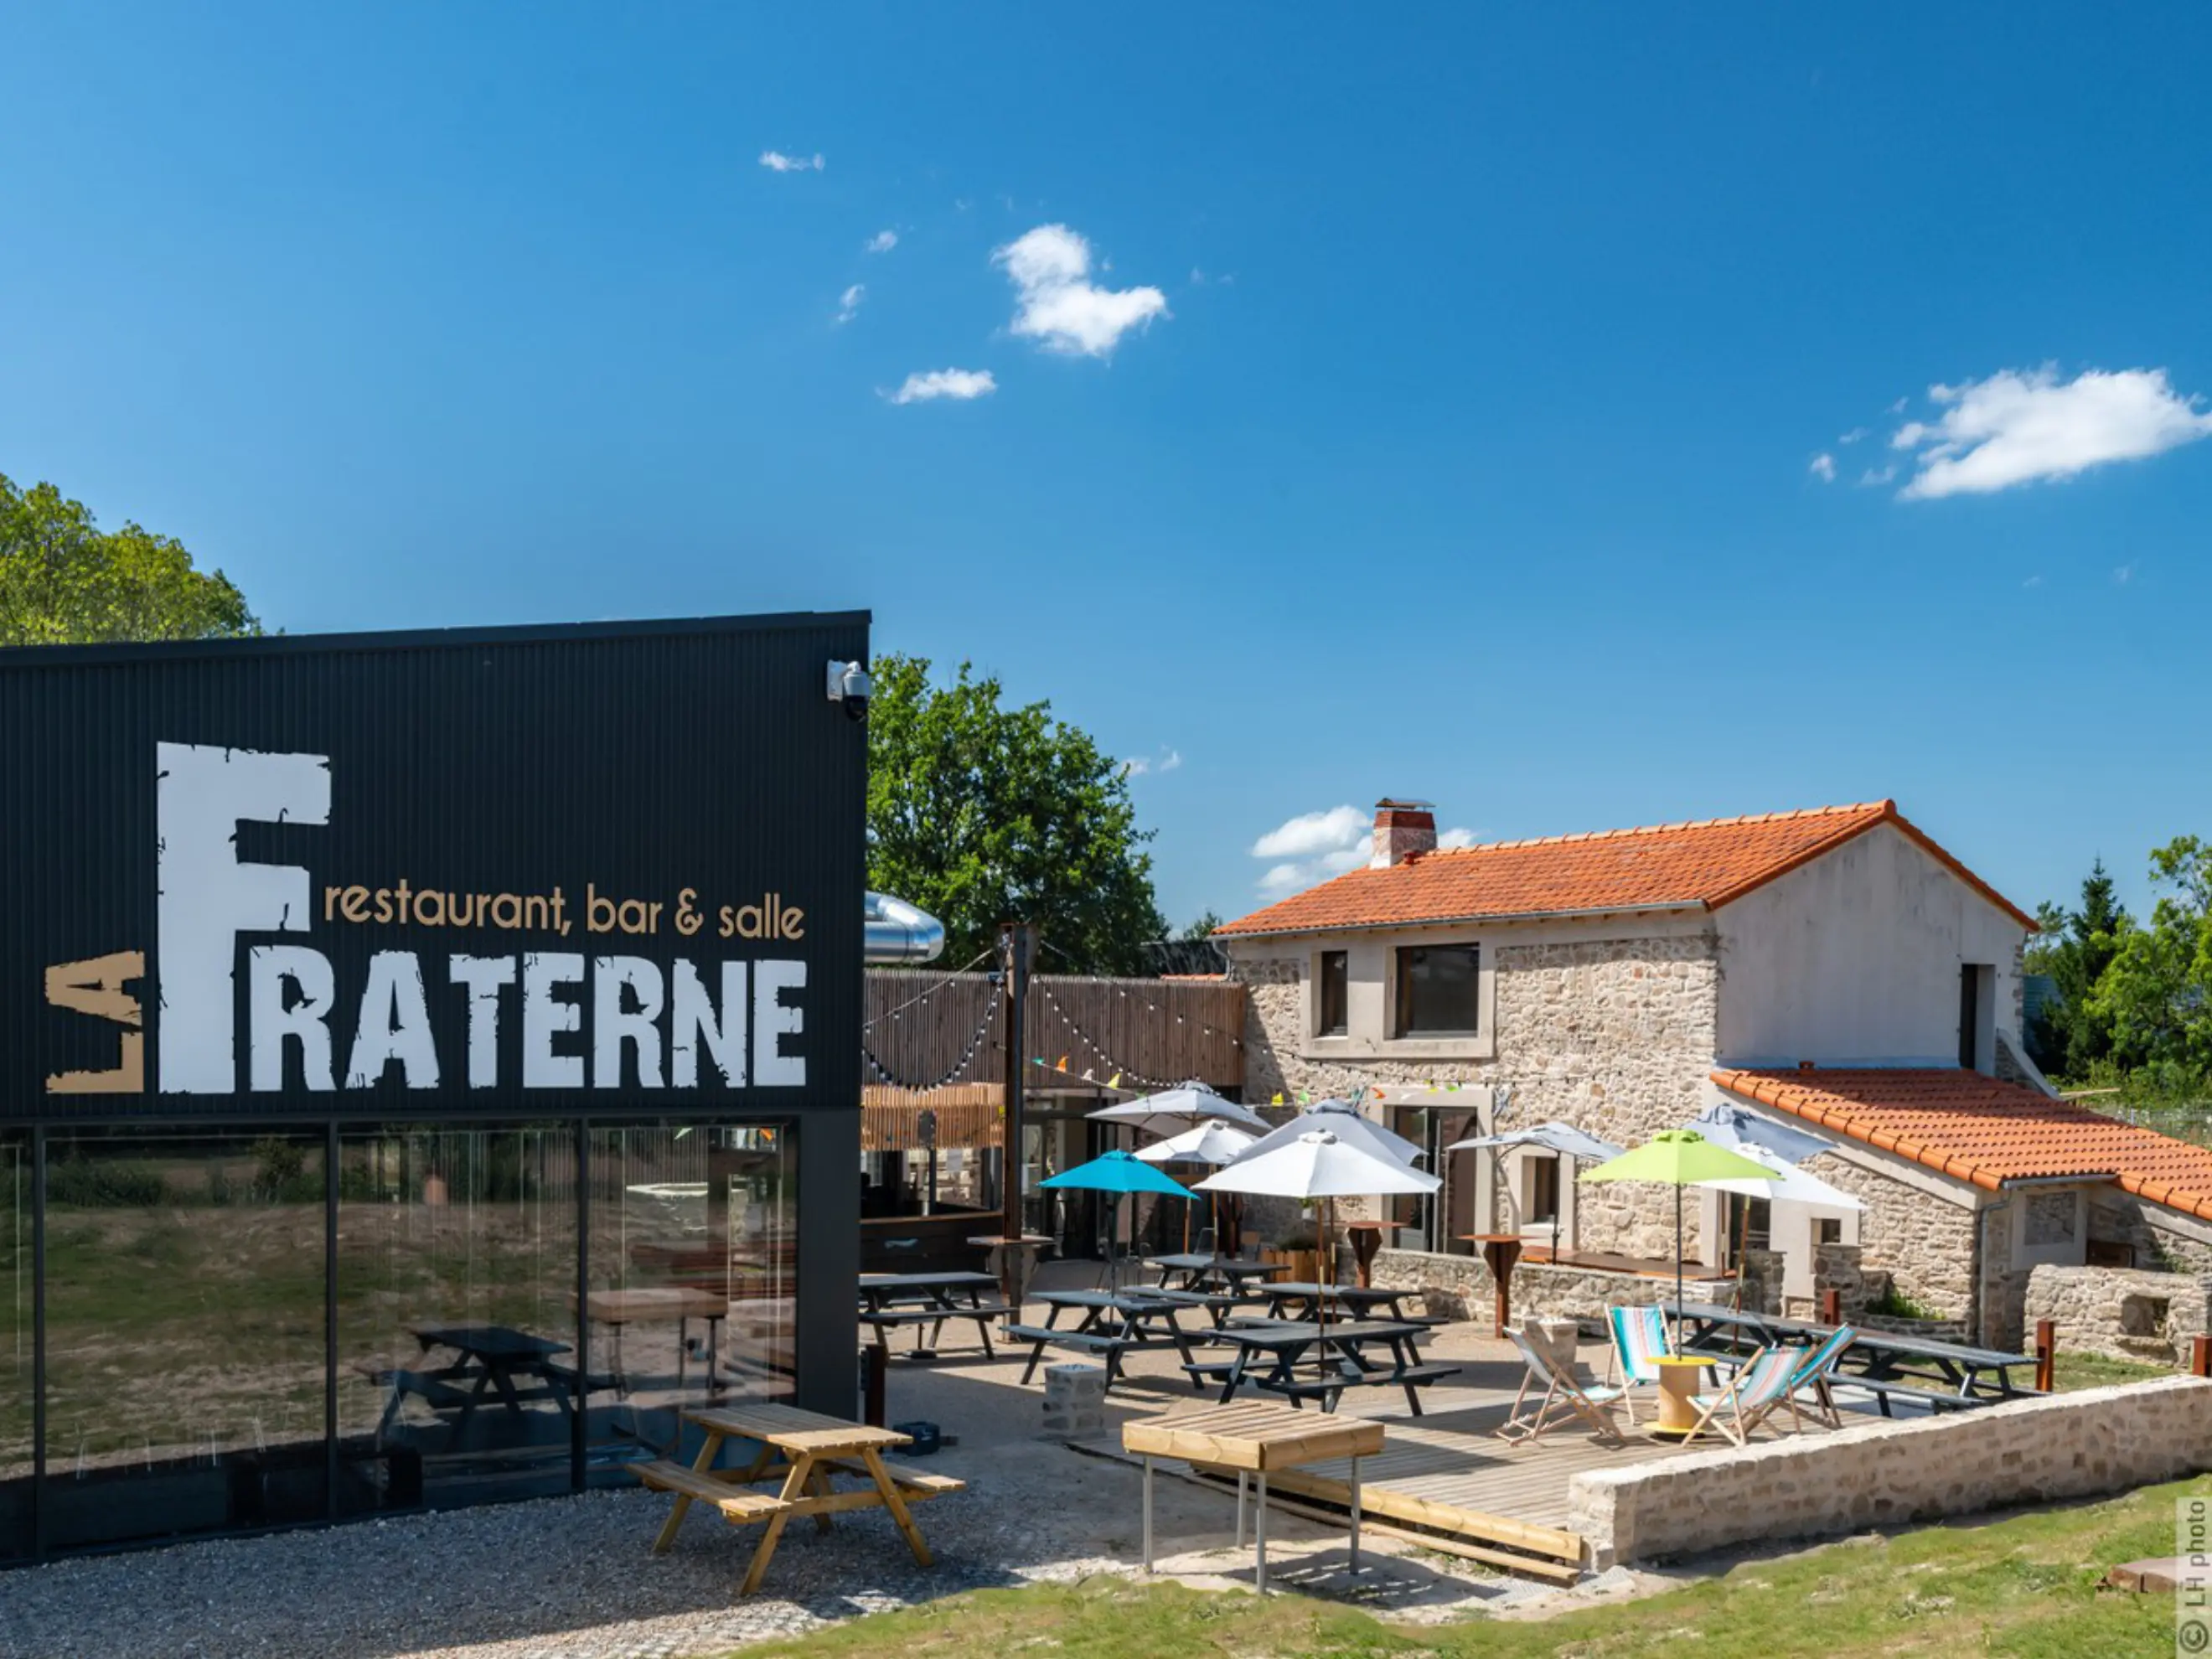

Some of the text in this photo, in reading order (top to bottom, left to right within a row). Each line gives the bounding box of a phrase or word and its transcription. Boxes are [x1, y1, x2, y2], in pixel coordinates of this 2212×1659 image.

[44, 741, 808, 1094] LA FRATERNE
[324, 879, 805, 940] restaurant, bar & salle
